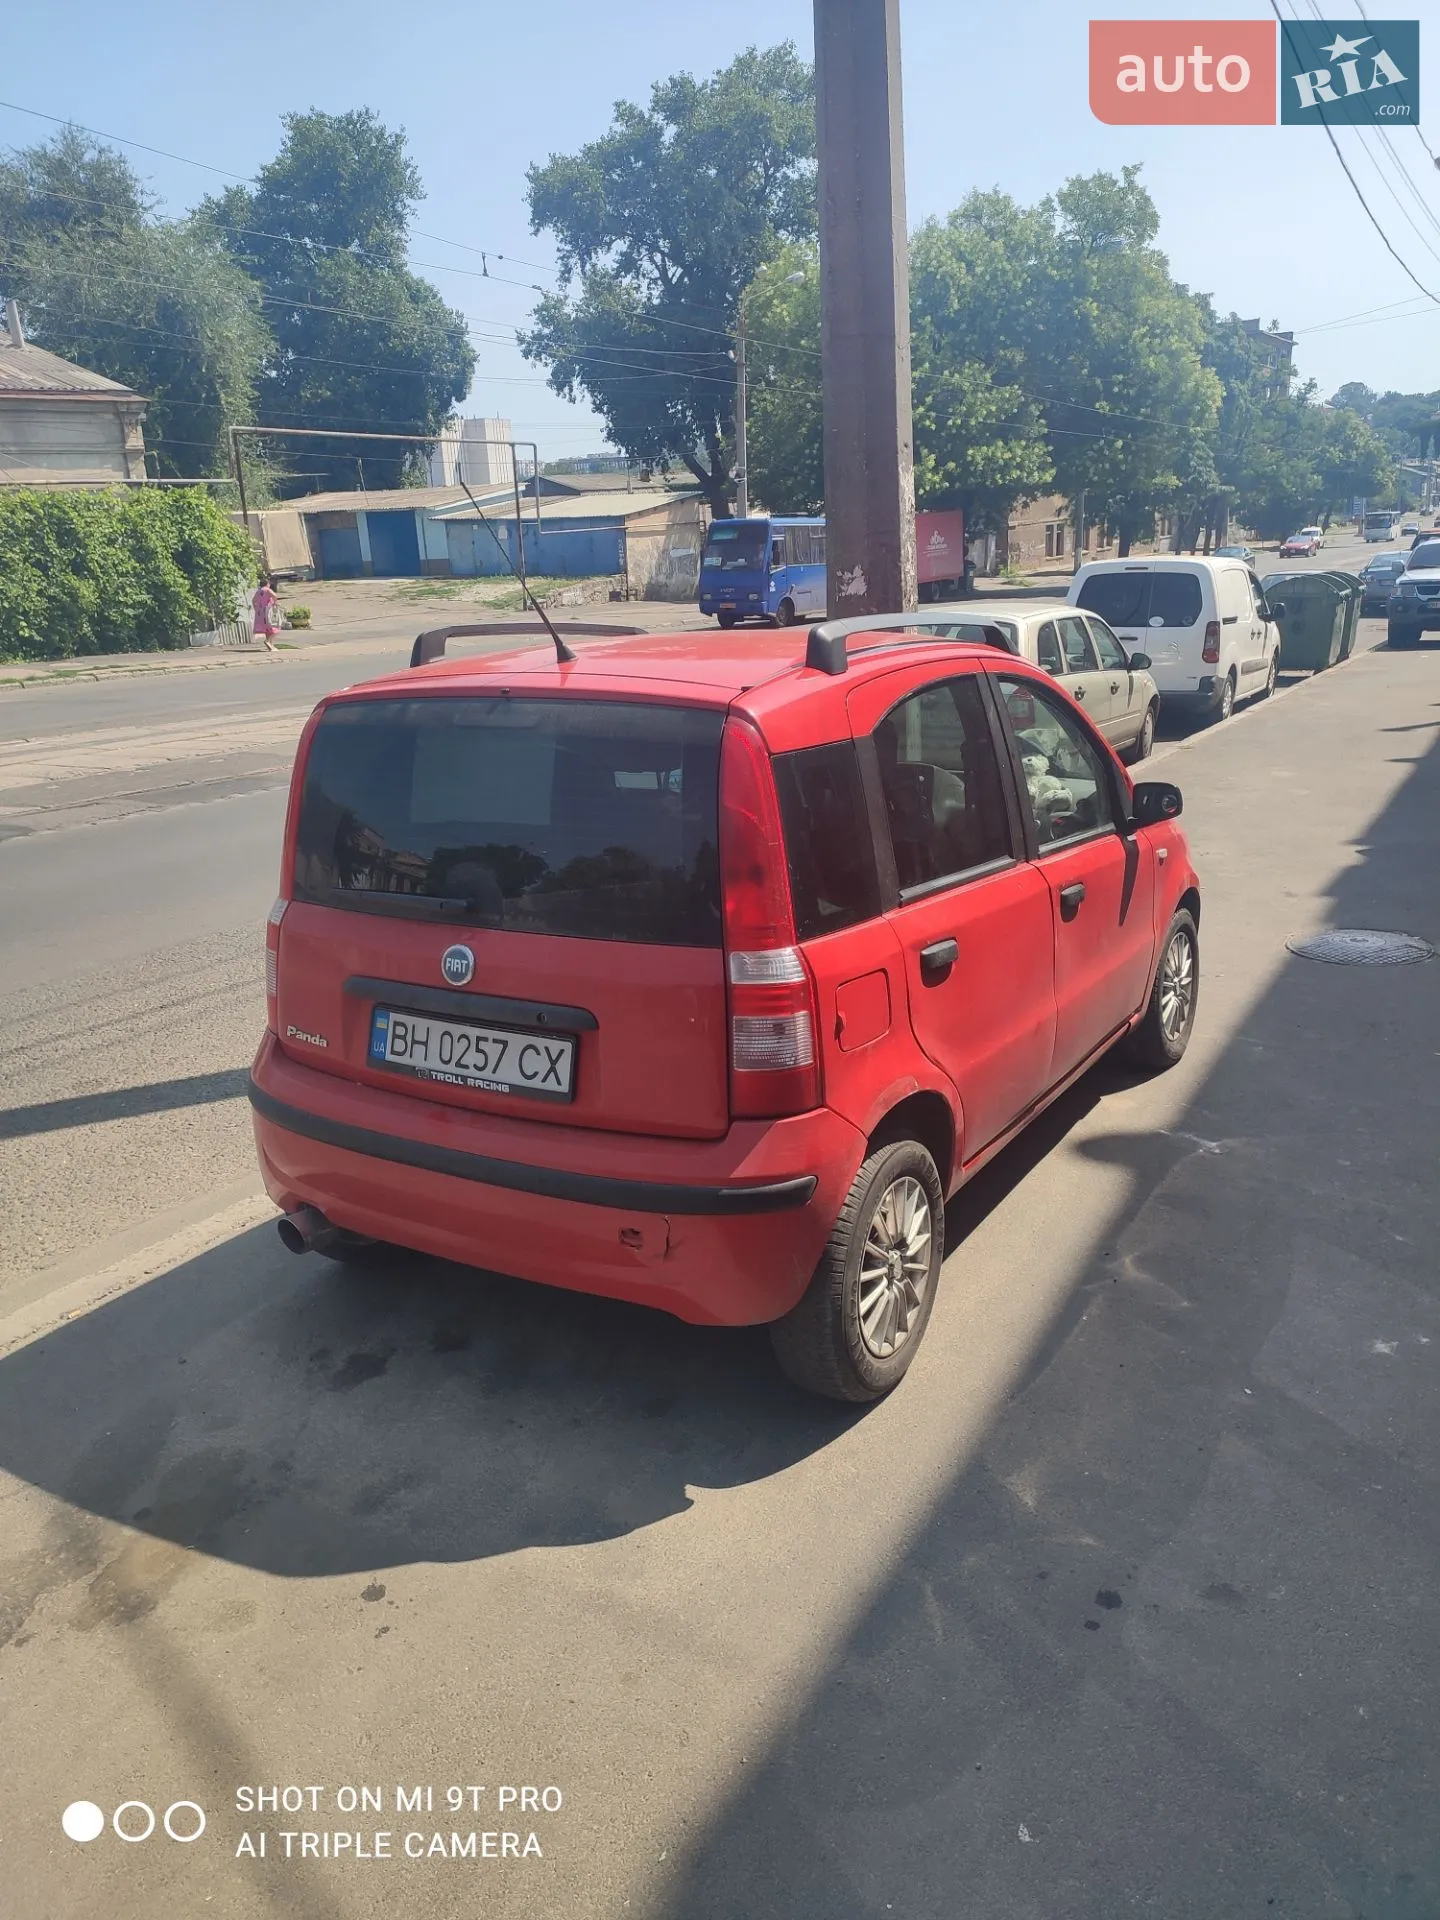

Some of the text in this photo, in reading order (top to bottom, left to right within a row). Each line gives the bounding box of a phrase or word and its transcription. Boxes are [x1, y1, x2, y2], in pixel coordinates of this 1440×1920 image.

[445, 957, 468, 973] FIAT
[286, 1025, 328, 1048] Panda
[373, 1041, 385, 1053] UA
[390, 1020, 565, 1086] BH 0257 CX
[430, 1071, 464, 1085] TROLL
[467, 1078, 510, 1093] RACING
